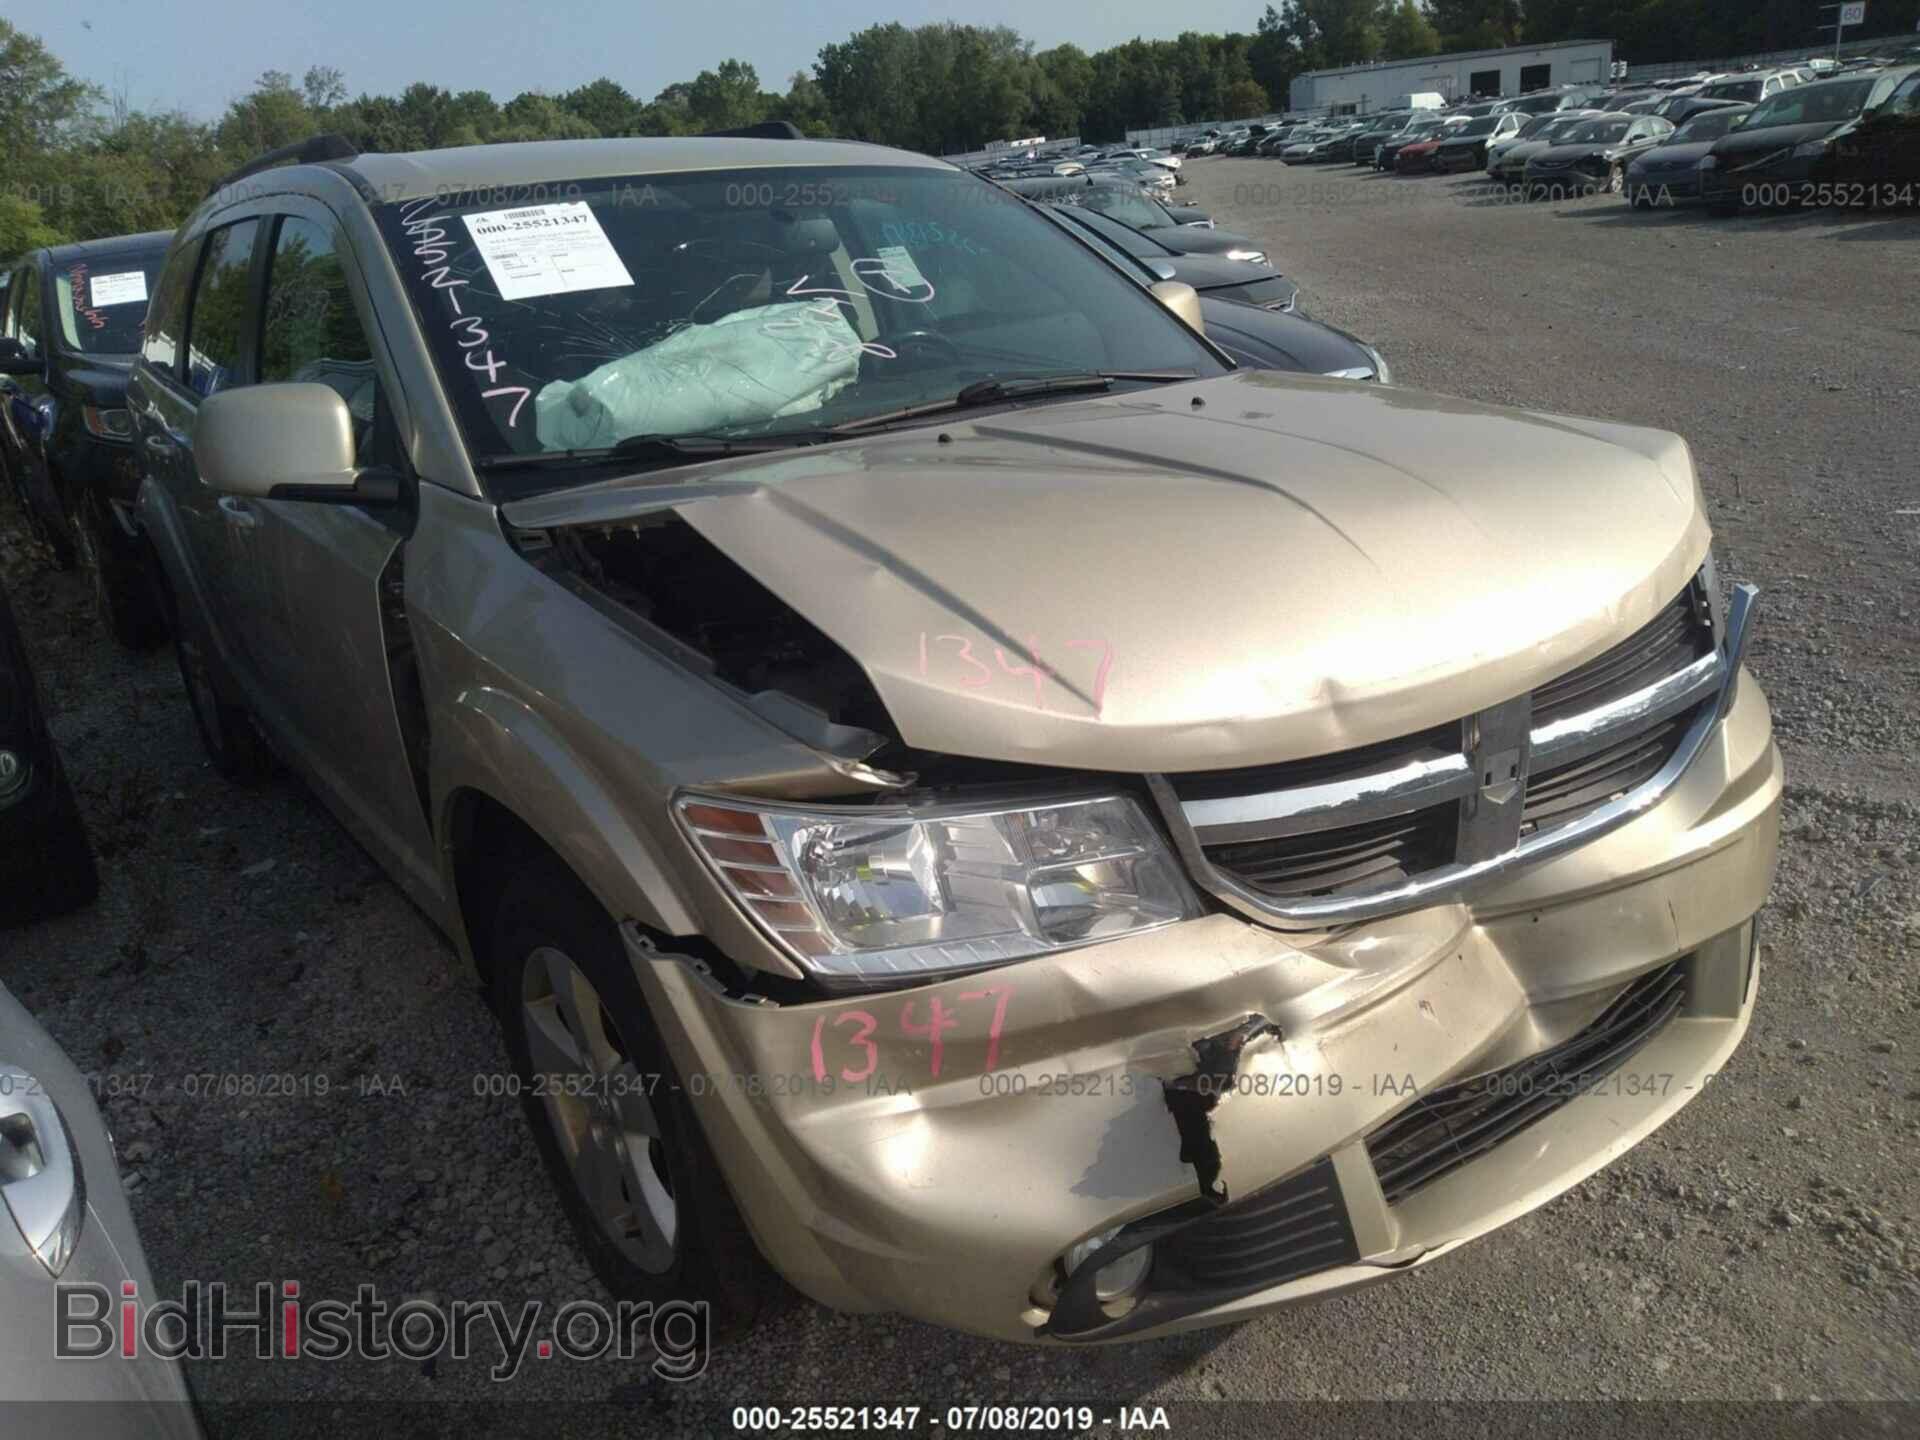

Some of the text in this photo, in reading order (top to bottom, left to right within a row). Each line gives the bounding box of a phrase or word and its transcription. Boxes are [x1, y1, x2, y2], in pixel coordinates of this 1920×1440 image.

[476, 213, 589, 237] 000-25521347
[919, 631, 1115, 720] 1347
[809, 984, 1018, 1083] 1347
